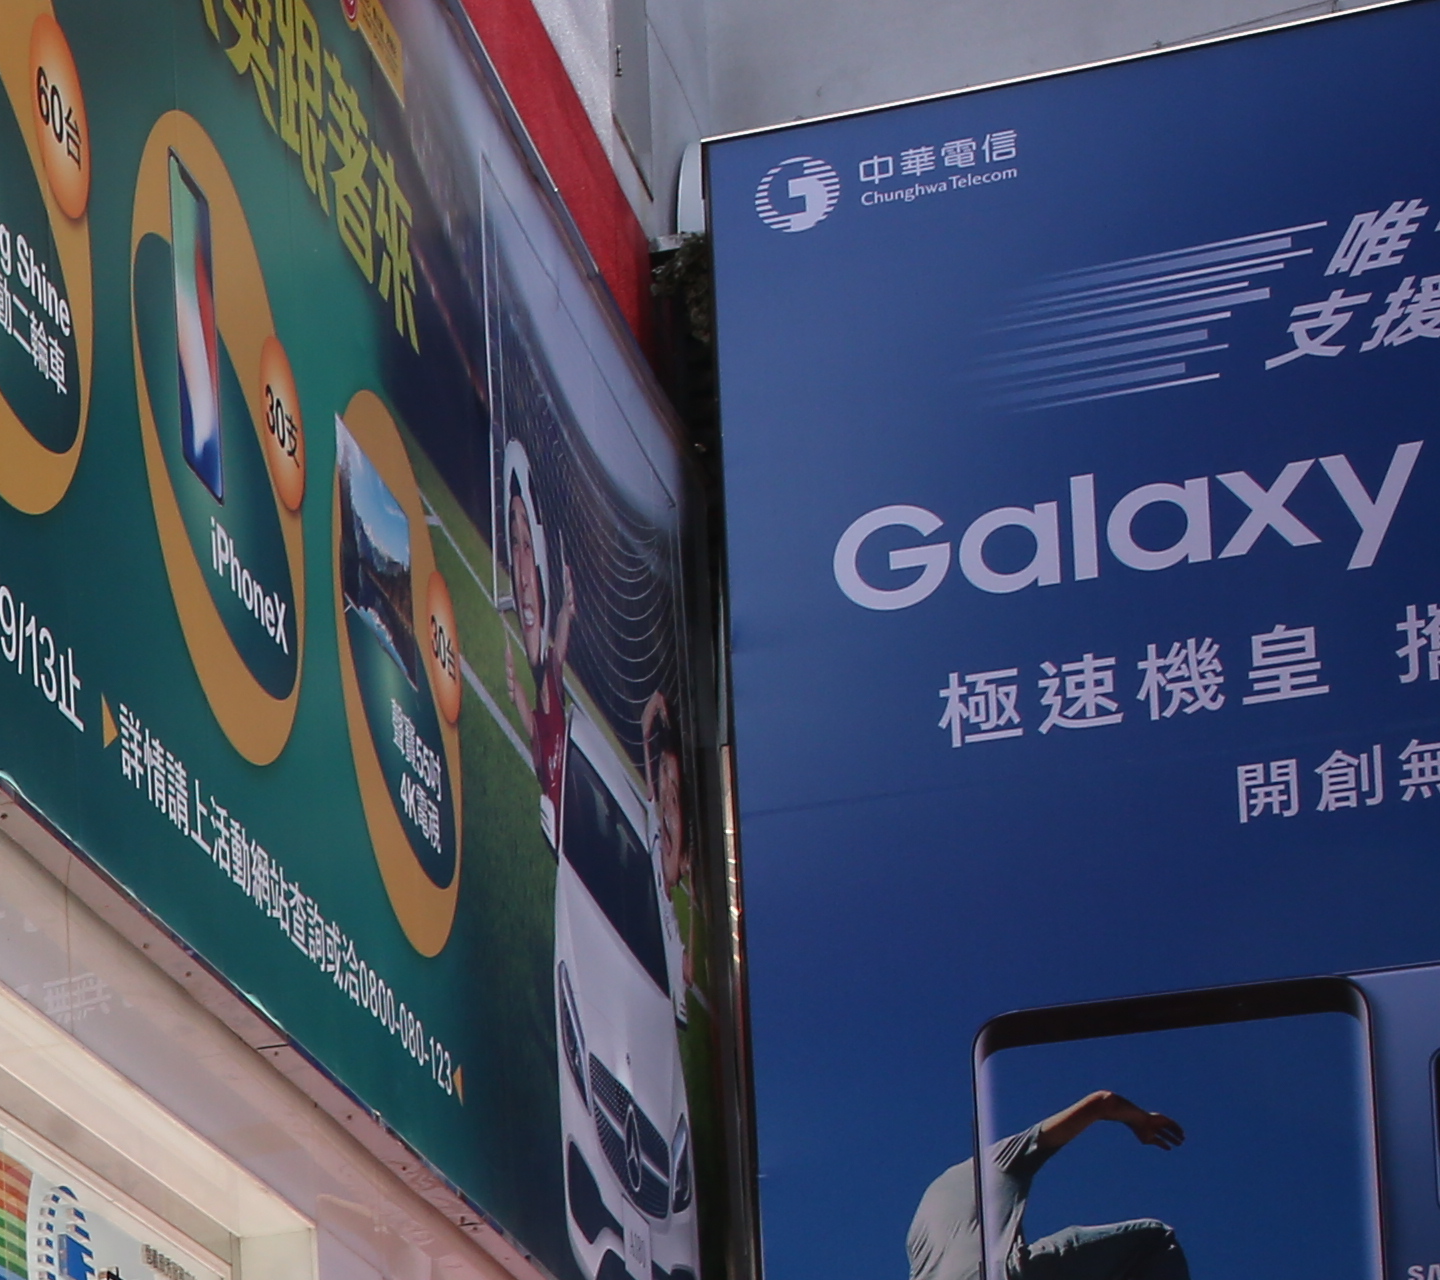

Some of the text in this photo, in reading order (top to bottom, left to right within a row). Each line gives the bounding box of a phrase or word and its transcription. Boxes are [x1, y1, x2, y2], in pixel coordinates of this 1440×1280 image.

[37, 66, 82, 171] 60台
[857, 129, 1018, 184] 中華電信
[861, 166, 1018, 207] Chunghwa Telecom
[1324, 198, 1440, 278] 唯
[16, 234, 71, 337] Shine
[264, 382, 300, 468] 30支
[834, 440, 1424, 611] Galaxy
[938, 624, 1330, 748] 極速機皇
